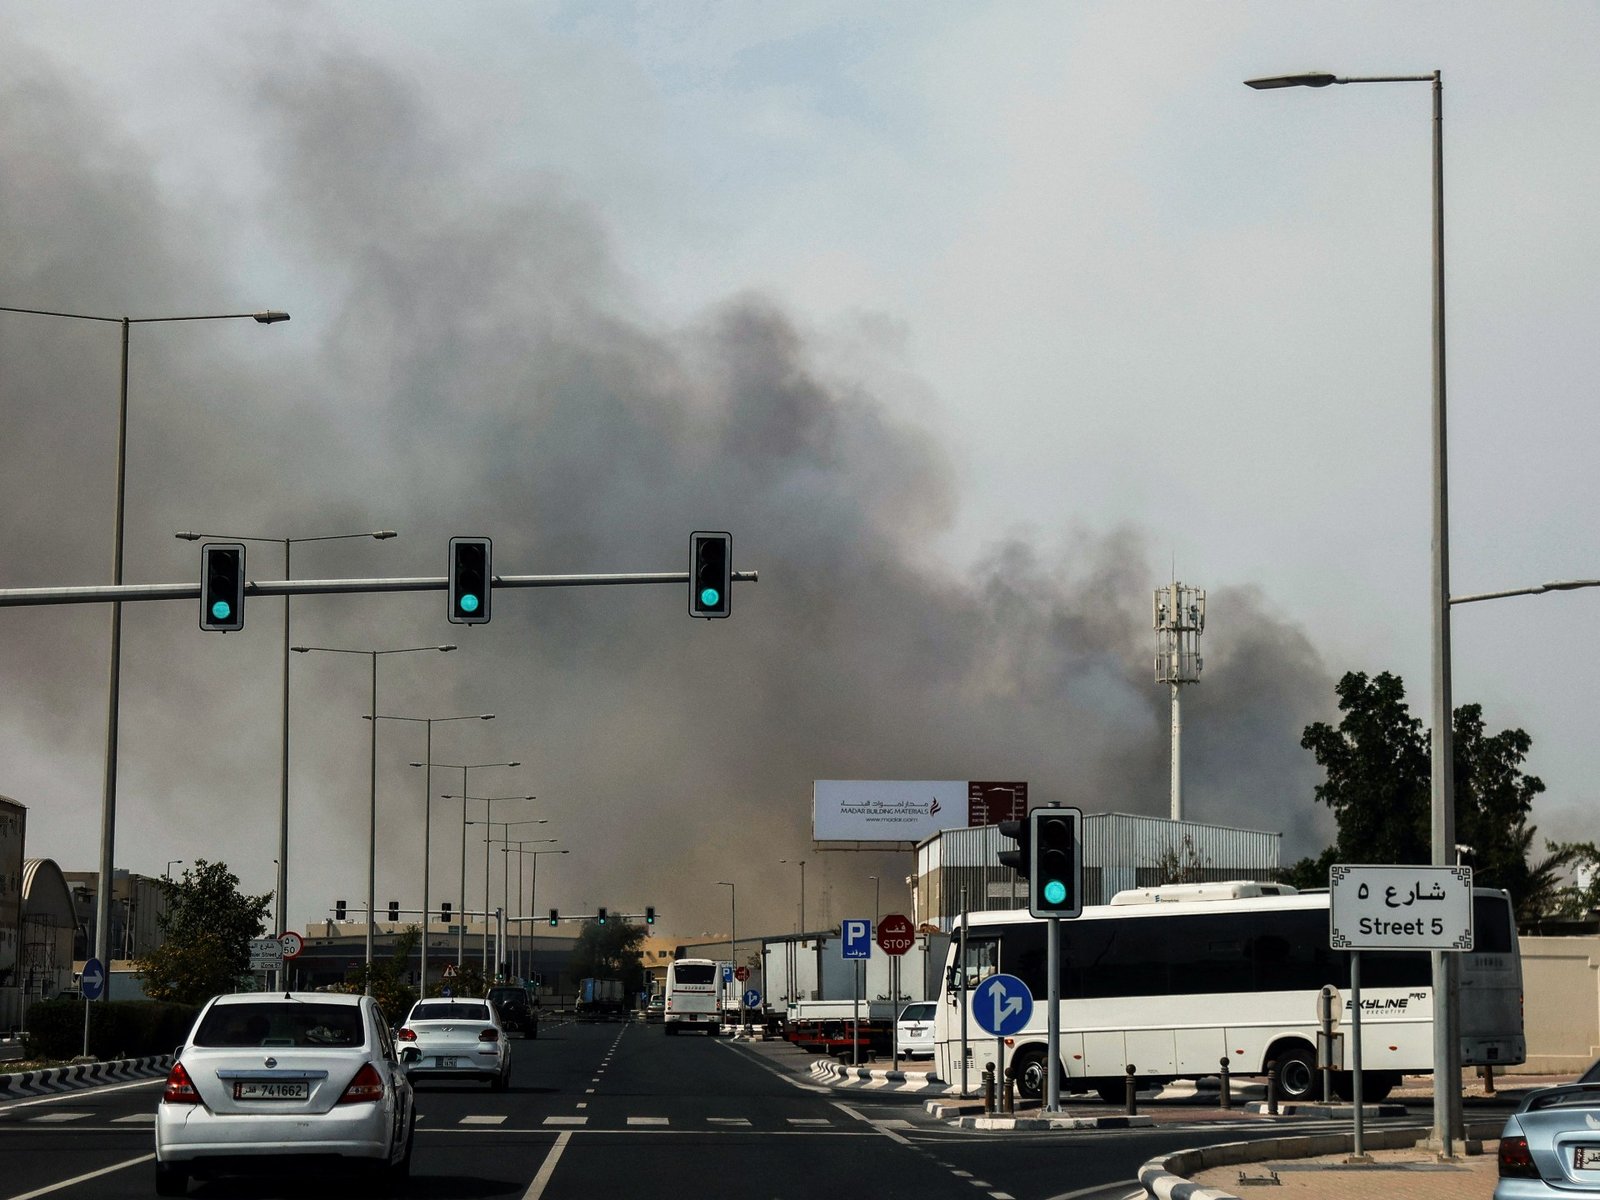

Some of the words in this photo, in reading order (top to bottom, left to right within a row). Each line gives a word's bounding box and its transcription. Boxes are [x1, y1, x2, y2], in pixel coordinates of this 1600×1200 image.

[1358, 883, 1369, 900] ٥
[1385, 881, 1446, 908] شارع
[885, 922, 906, 933] قف
[1359, 917, 1424, 935] Street
[1431, 918, 1444, 935] 5
[848, 922, 866, 946] P
[283, 946, 295, 954] 50
[883, 940, 911, 949] STOP
[846, 949, 867, 957] موقف
[1409, 992, 1427, 1000] PRO
[261, 1084, 303, 1097] 741662
